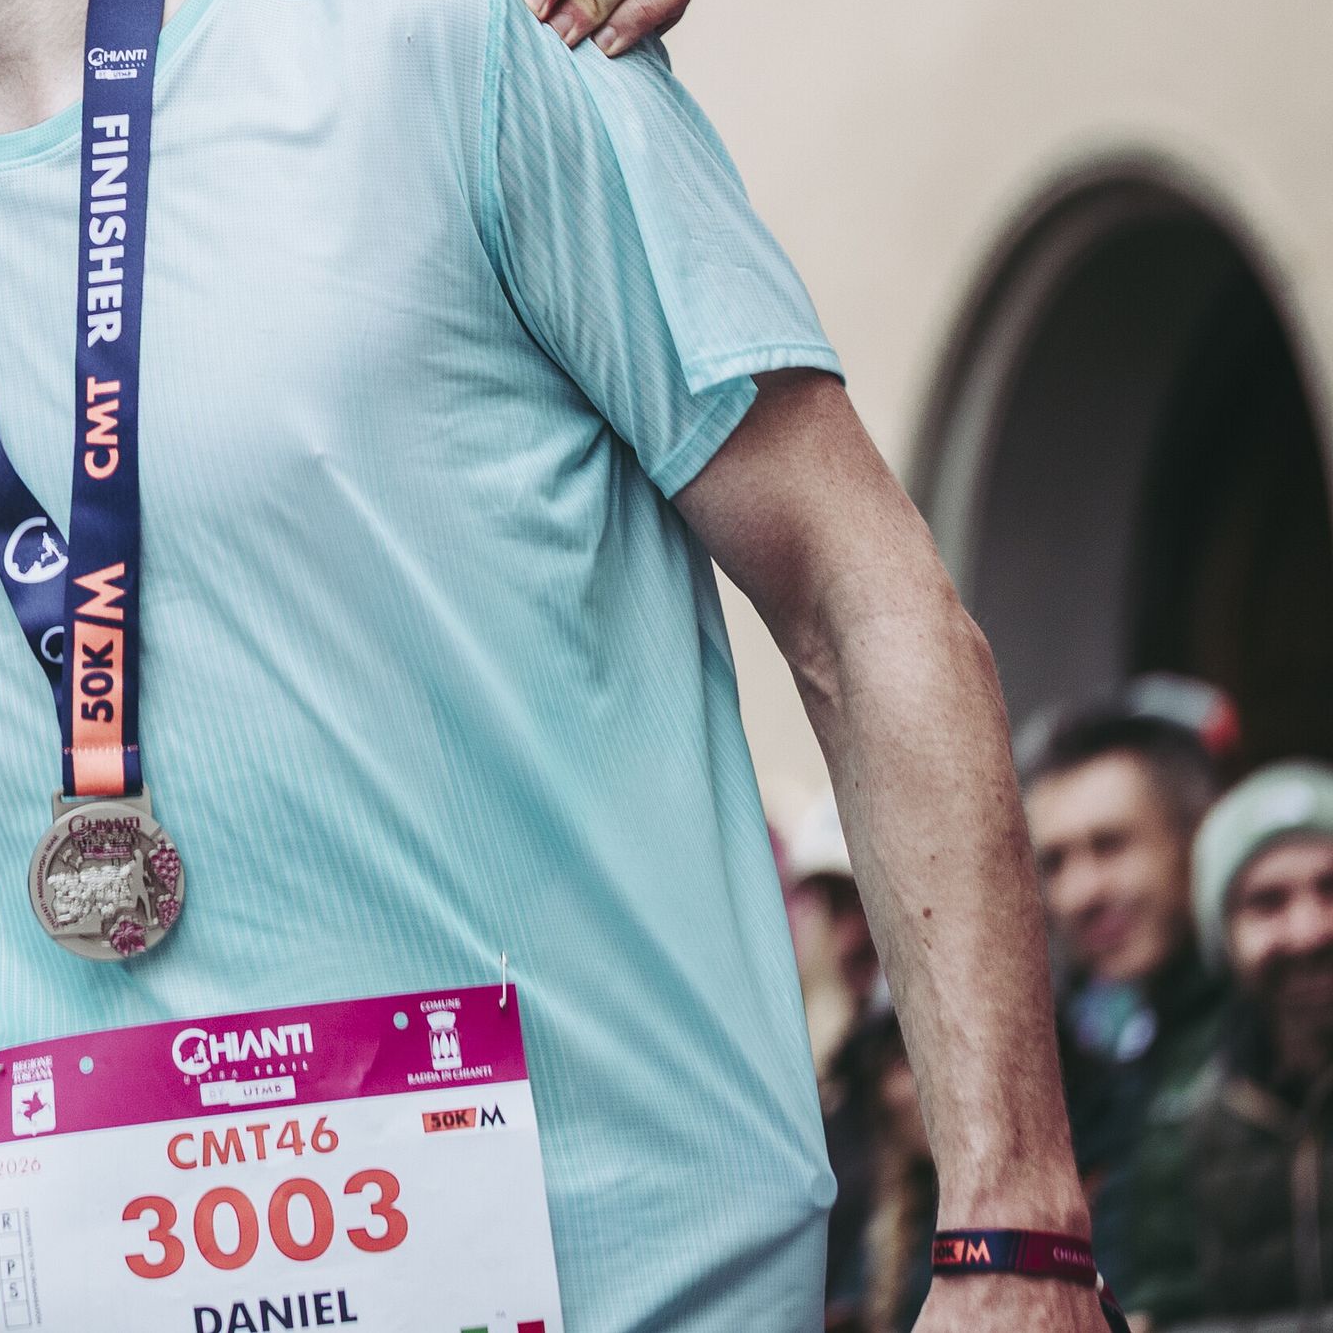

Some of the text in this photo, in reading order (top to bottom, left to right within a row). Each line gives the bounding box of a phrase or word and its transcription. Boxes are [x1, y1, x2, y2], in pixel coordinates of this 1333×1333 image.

[88, 48, 147, 67] CHIANTI
[87, 113, 130, 348] FINISHER
[84, 376, 120, 481] CMT
[80, 639, 114, 724] 50K
[419, 998, 461, 1013] COMUNE
[171, 1022, 314, 1076] CHIANTI
[167, 1115, 339, 1170] CMT46
[122, 1168, 409, 1280] 3003
[194, 1290, 358, 1333] DANIEL
